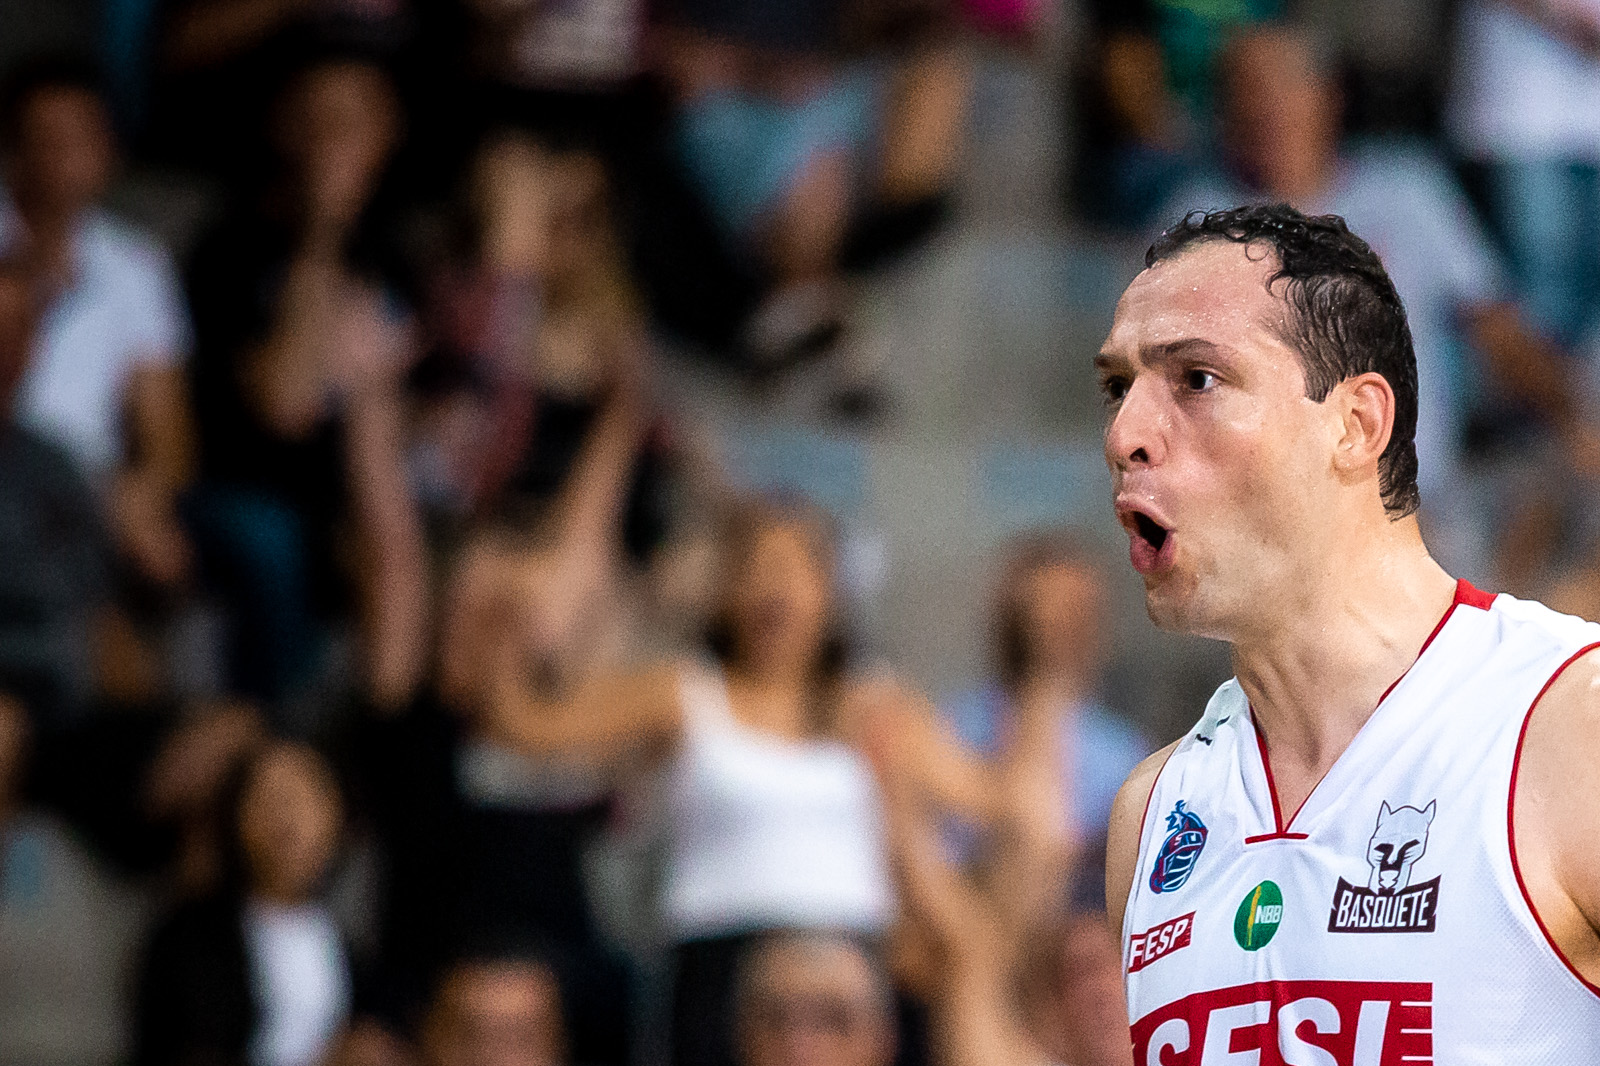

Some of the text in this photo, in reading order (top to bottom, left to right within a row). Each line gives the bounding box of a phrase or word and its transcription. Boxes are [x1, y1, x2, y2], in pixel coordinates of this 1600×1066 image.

[1254, 904, 1282, 925] NBB
[1335, 889, 1432, 928] BASQUETE
[1129, 923, 1185, 967] FESP
